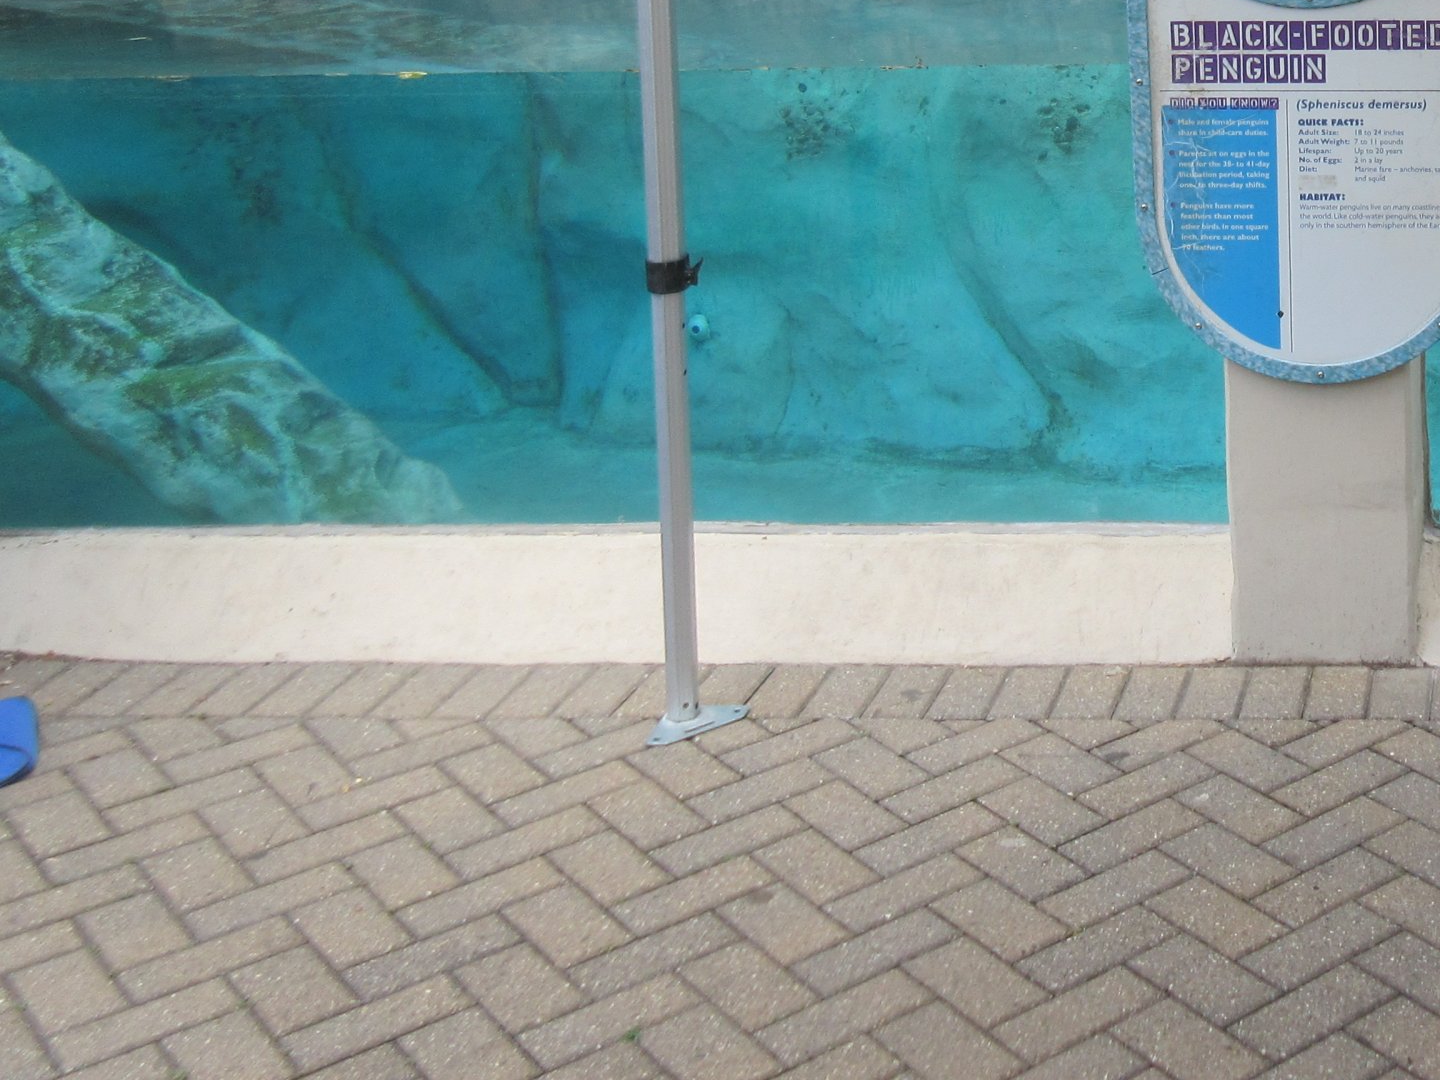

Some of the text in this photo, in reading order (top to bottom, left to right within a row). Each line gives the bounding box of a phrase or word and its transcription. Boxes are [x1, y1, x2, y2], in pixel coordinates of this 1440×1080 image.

[1173, 55, 1326, 82] PENGUIN
[1171, 98, 1279, 110] DID YOU KNOW?
[1296, 99, 1427, 112] (Spheniscus demersus)
[1321, 138, 1350, 146] Weight:
[1380, 138, 1404, 146] pounds
[1298, 147, 1332, 156] Lifespan:
[1354, 147, 1364, 156] Up
[1323, 157, 1342, 166] Eggs:
[1374, 157, 1383, 166] lay
[1368, 175, 1386, 183] squid
[1300, 193, 1346, 201] HABITAT:
[1339, 204, 1368, 212] penguins
[1386, 213, 1418, 222] penguins,
[1419, 213, 1433, 222] they
[1299, 222, 1314, 230] only
[1368, 222, 1407, 230] hemisphere
